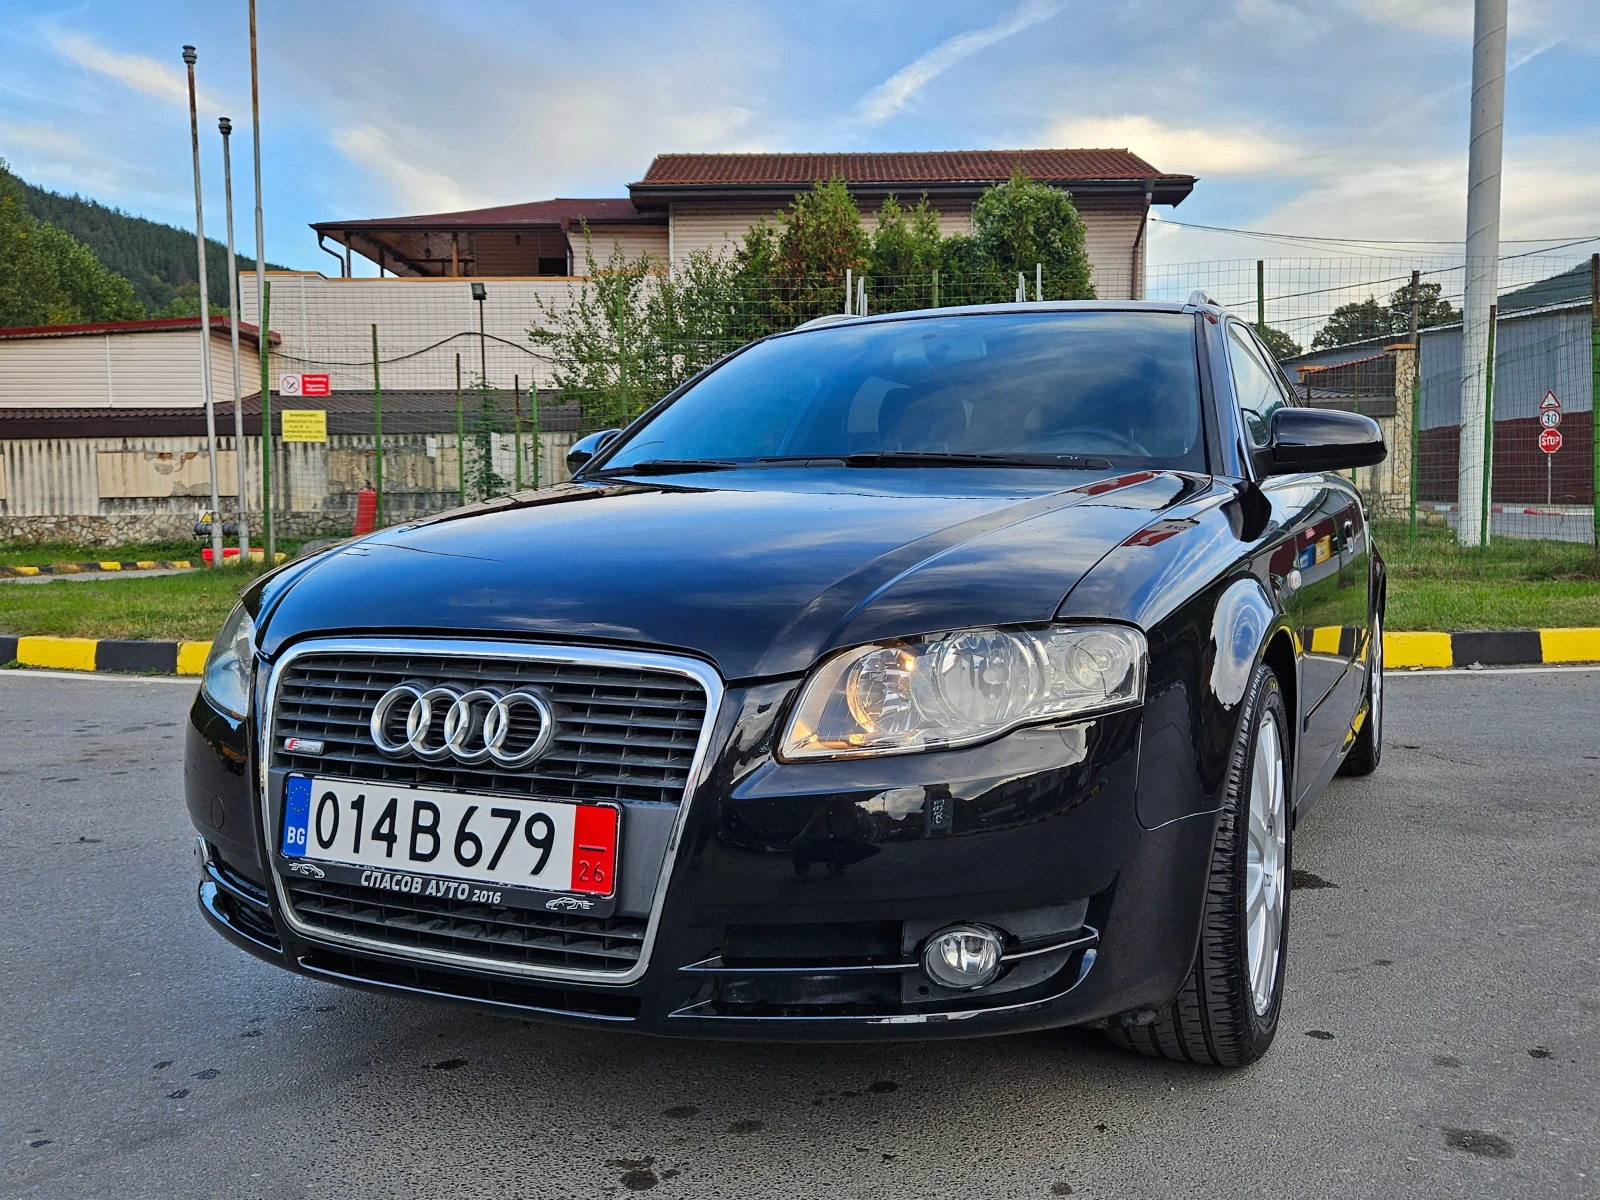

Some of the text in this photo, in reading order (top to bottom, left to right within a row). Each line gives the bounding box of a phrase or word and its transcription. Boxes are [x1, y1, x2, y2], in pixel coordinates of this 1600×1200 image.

[1544, 414, 1557, 424] 30
[1541, 436, 1560, 446] STOP
[286, 826, 305, 845] BG
[577, 860, 605, 884] 26
[360, 870, 502, 905] СПАСОВ АУТО 2016
